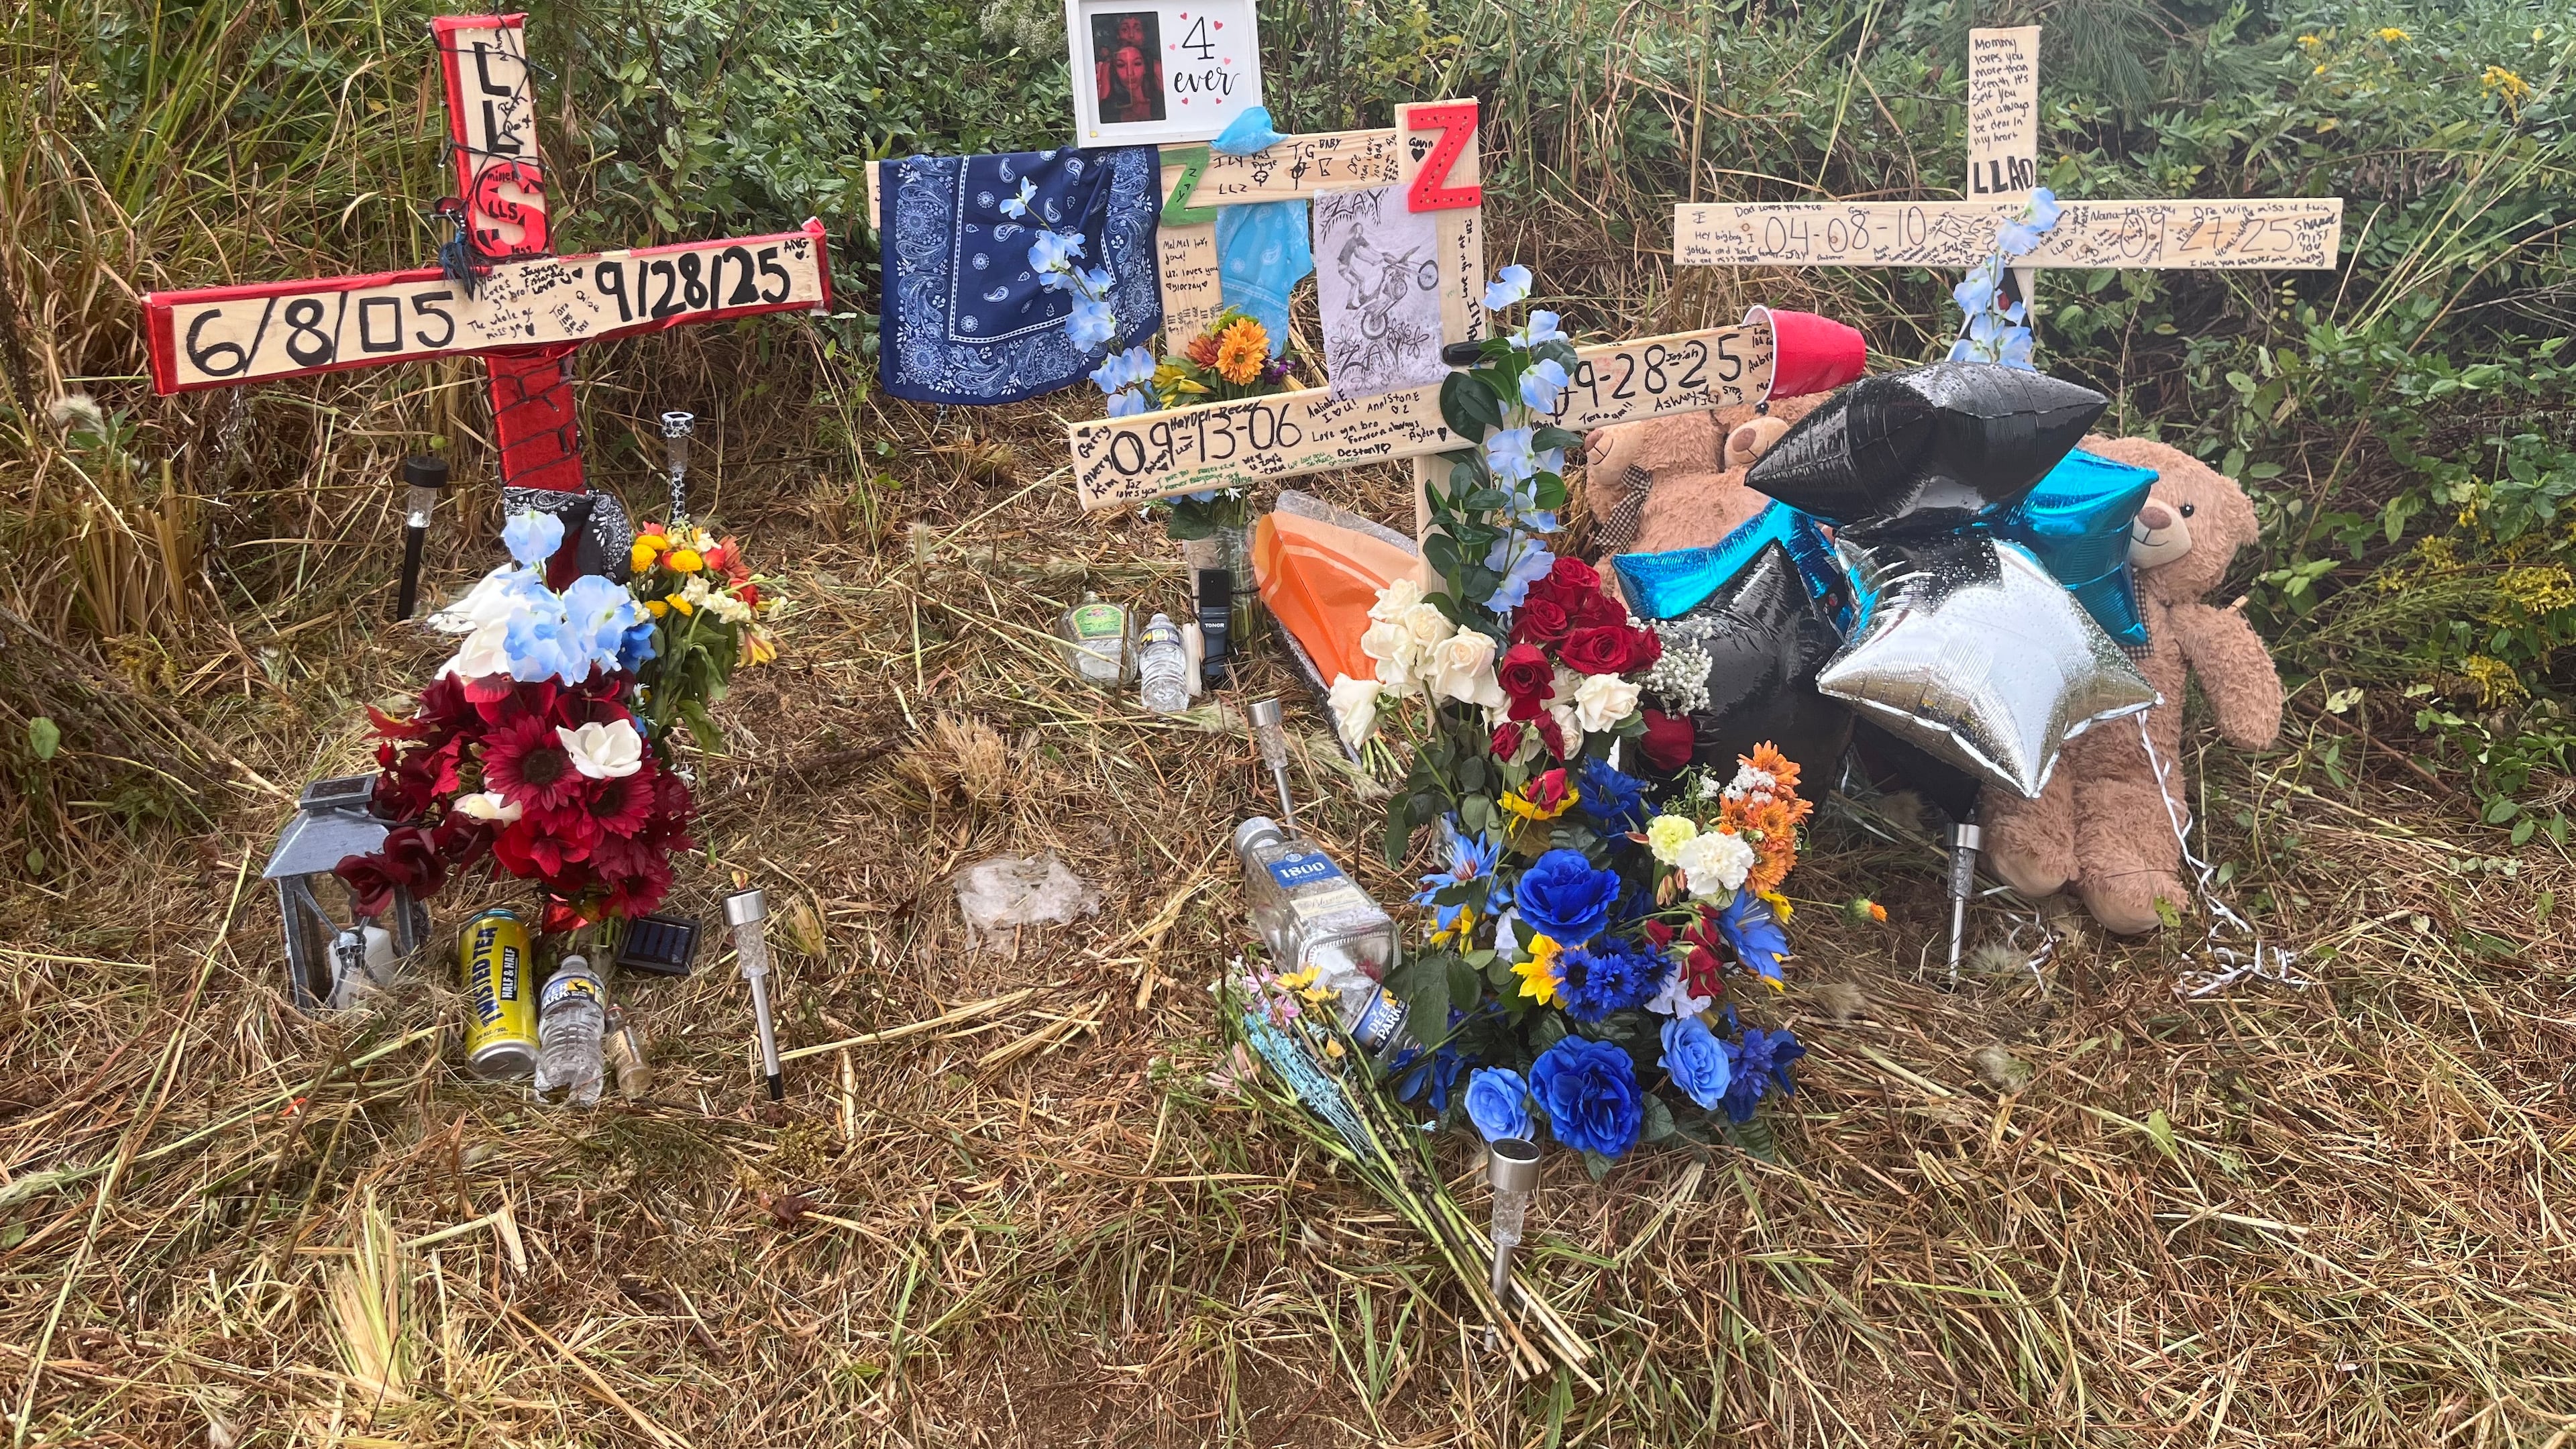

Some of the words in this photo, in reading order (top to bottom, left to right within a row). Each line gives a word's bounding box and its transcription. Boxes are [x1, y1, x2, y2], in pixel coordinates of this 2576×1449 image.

[1182, 16, 1215, 60] 4
[1975, 38, 2016, 53] Mommy
[1174, 66, 1240, 96] ever
[1319, 138, 1342, 151] BABY
[1409, 105, 1481, 212] Z
[1973, 156, 2033, 194] LLAD
[488, 200, 518, 220] LLS
[1734, 205, 1755, 217] Dad
[1695, 231, 1710, 241] Hey
[2050, 239, 2073, 256] LLAD
[1182, 268, 1203, 277] loves
[186, 290, 455, 377] 6/8/05
[1091, 478, 1120, 500] Kim
[1280, 861, 1326, 878] 1800
[473, 926, 499, 961] TEA
[504, 947, 517, 968] HALF
[506, 969, 515, 977] &
[472, 958, 504, 1028] TWISTED
[501, 977, 515, 999] HALF
[1367, 1001, 1392, 1034] DEER
[1377, 1006, 1402, 1041] PARK
